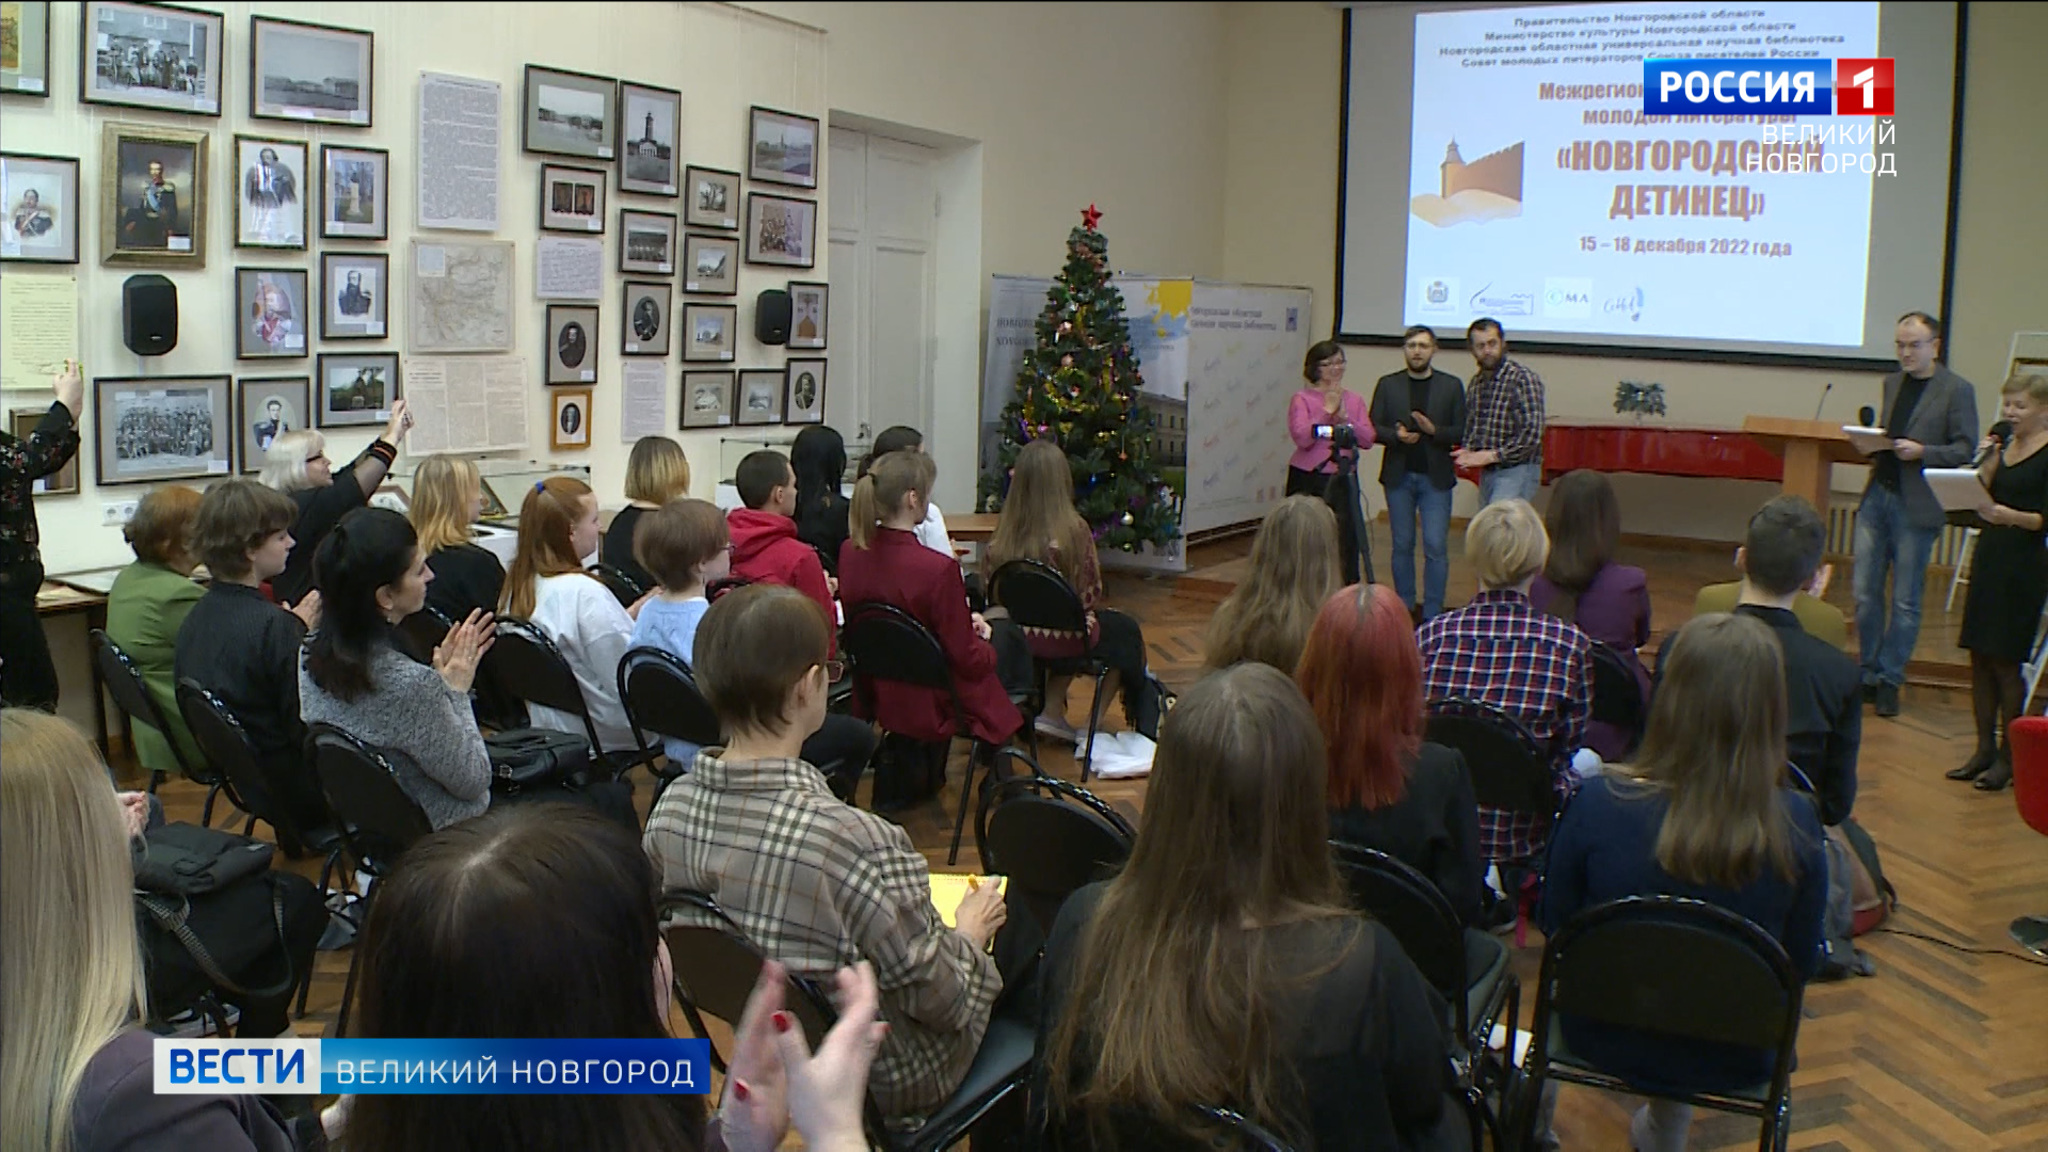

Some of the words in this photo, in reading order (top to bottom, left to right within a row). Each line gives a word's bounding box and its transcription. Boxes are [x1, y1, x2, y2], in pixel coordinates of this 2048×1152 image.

[1514, 16, 1610, 28] Правительство
[1614, 11, 1706, 24] Новгородской
[1711, 9, 1765, 19] области
[1485, 29, 1575, 41] Министерство
[1579, 27, 1640, 39] культуры
[1644, 24, 1737, 36] Новгородской
[1741, 22, 1796, 32] области
[1440, 44, 1527, 57] Новгородская
[1531, 40, 1597, 51] областная
[1602, 38, 1702, 51] универсальная
[1707, 36, 1761, 47] научная
[1765, 34, 1845, 45] библиотека
[1462, 58, 1497, 68] Совет
[1501, 56, 1558, 67] молодых
[1563, 53, 1643, 65] литераторов
[1770, 48, 1820, 58] России
[1609, 185, 1765, 221] ДЕТИНЕЦ»
[1580, 236, 1597, 251] 15
[1614, 236, 1630, 252] 18
[1634, 238, 1706, 254] декабря
[1710, 238, 1750, 255] 2022
[1753, 241, 1792, 257] года
